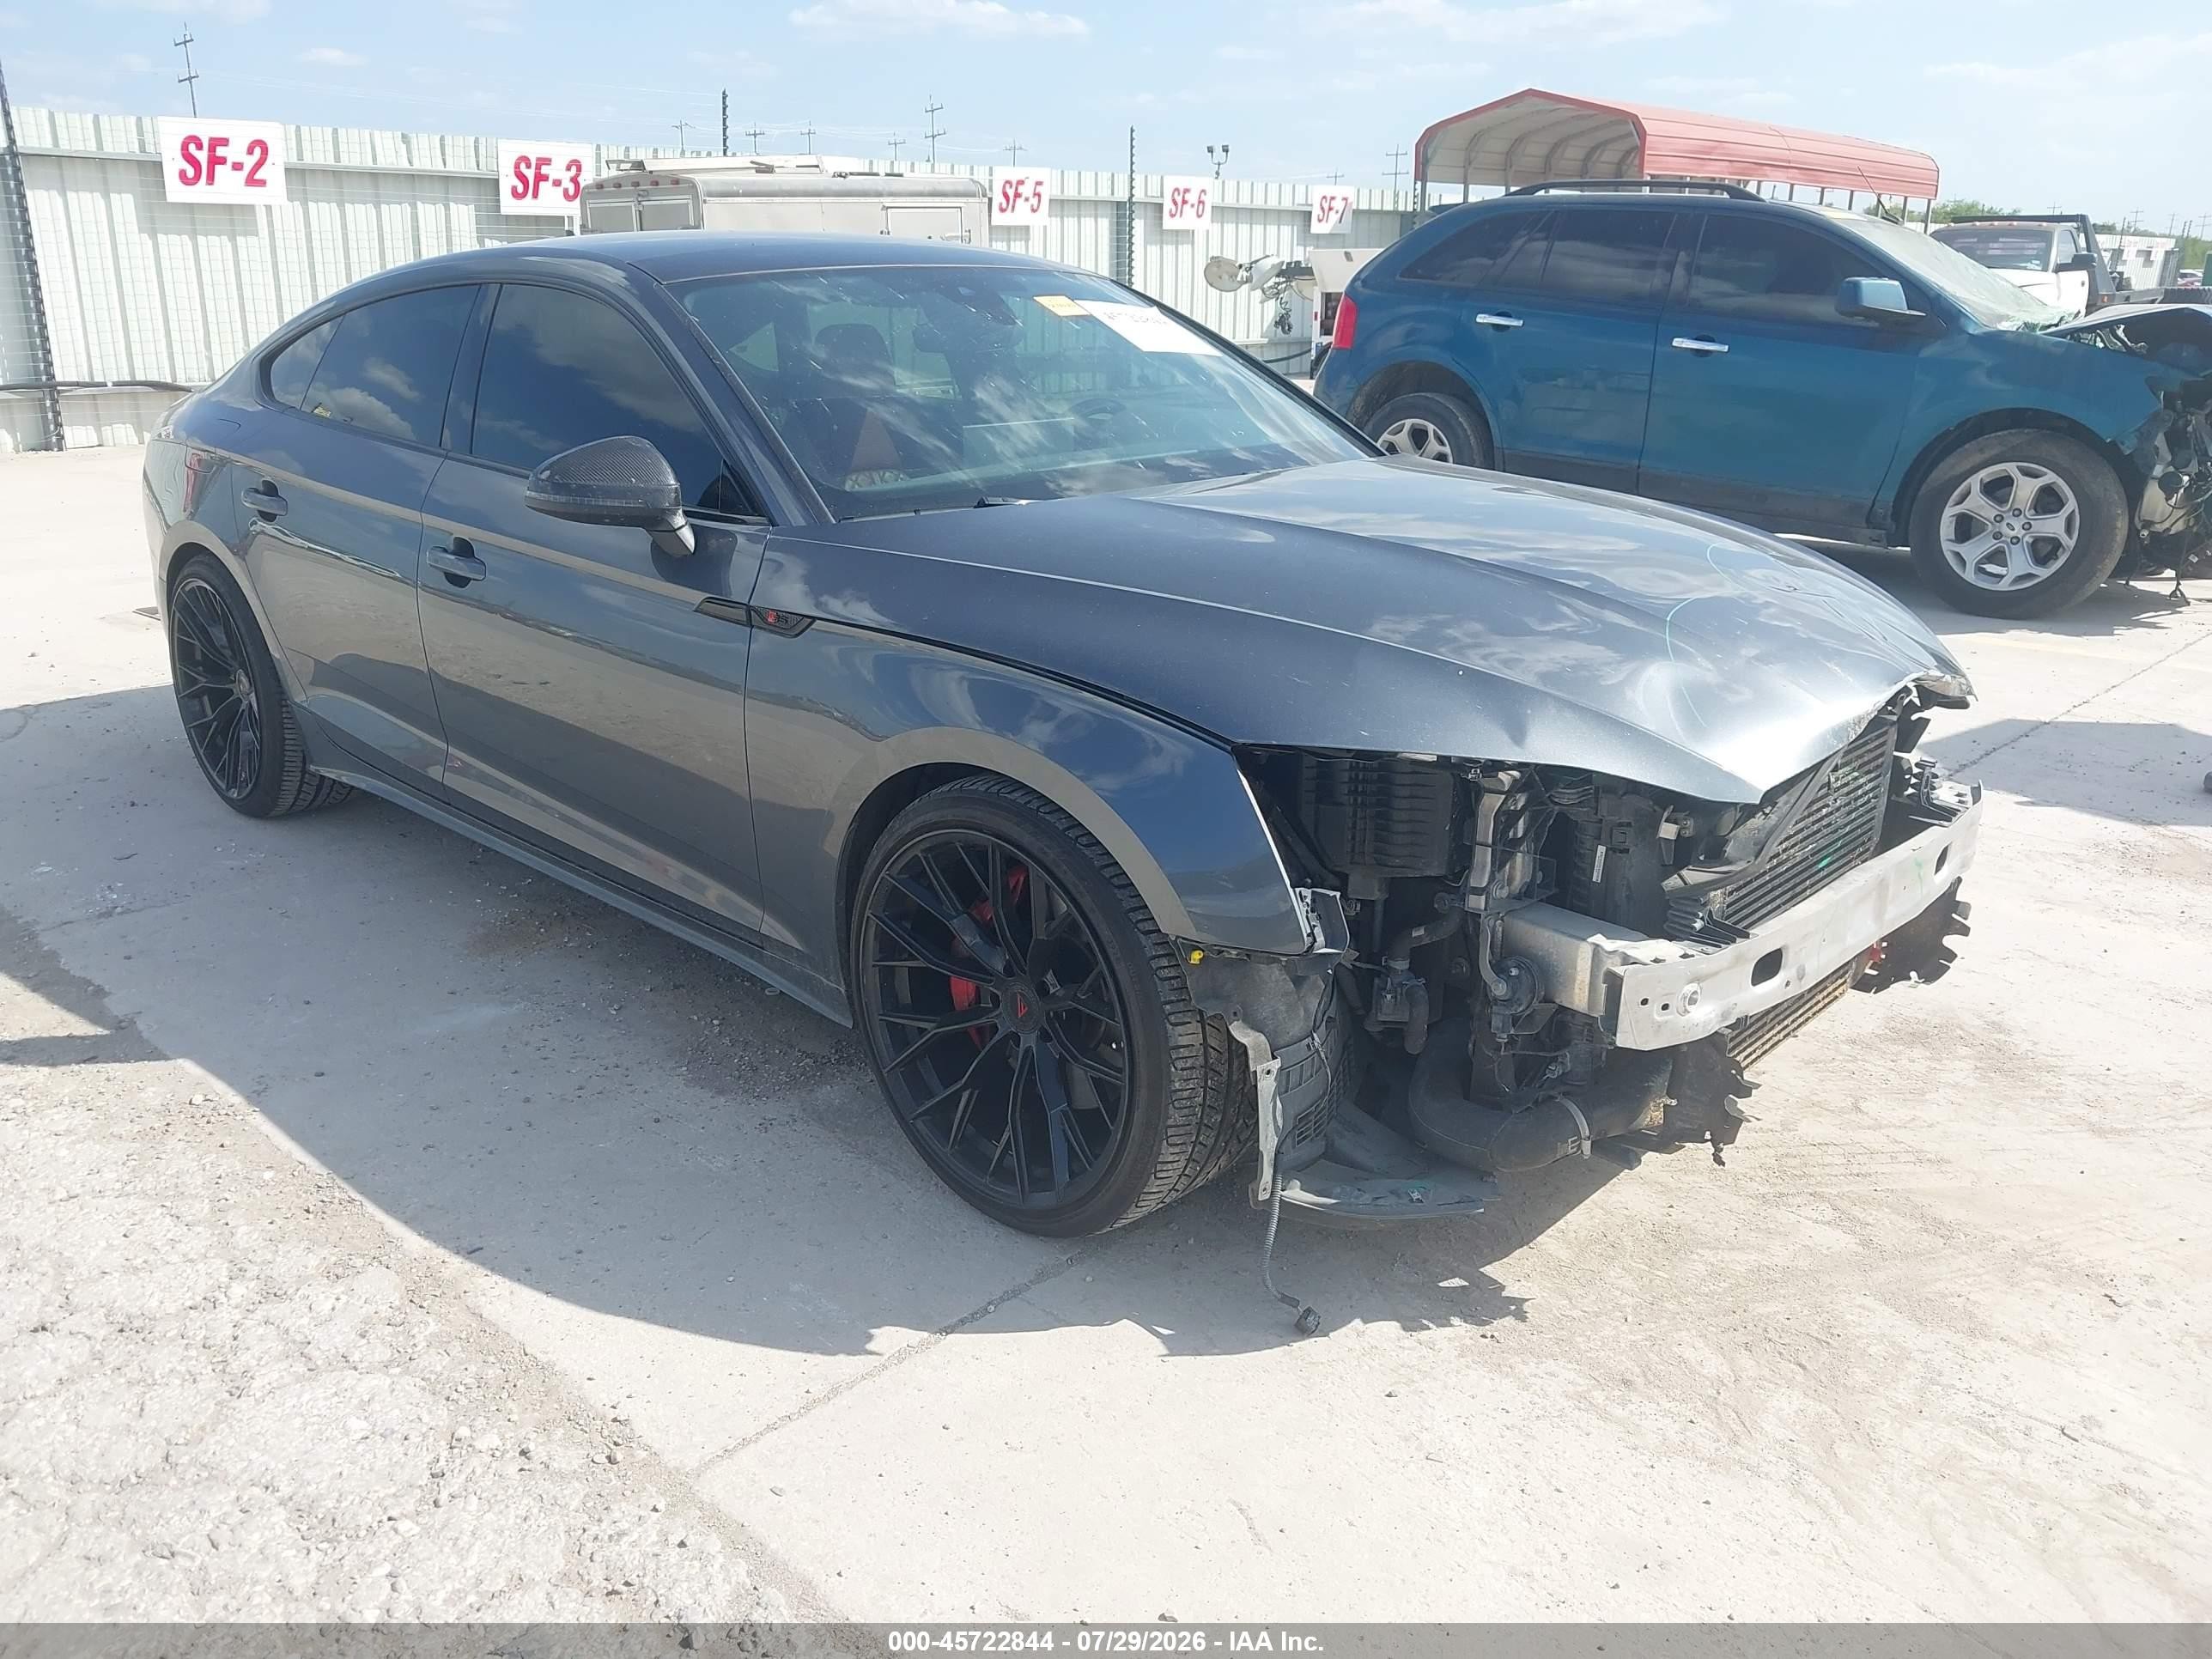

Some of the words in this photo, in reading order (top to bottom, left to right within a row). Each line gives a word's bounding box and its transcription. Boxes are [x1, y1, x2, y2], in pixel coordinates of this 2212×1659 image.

[179, 134, 270, 187] SF-2
[511, 155, 582, 202] SF-3
[999, 179, 1044, 214] SF-5
[1169, 187, 1207, 219] SF-6
[1317, 195, 1349, 224] SF-7
